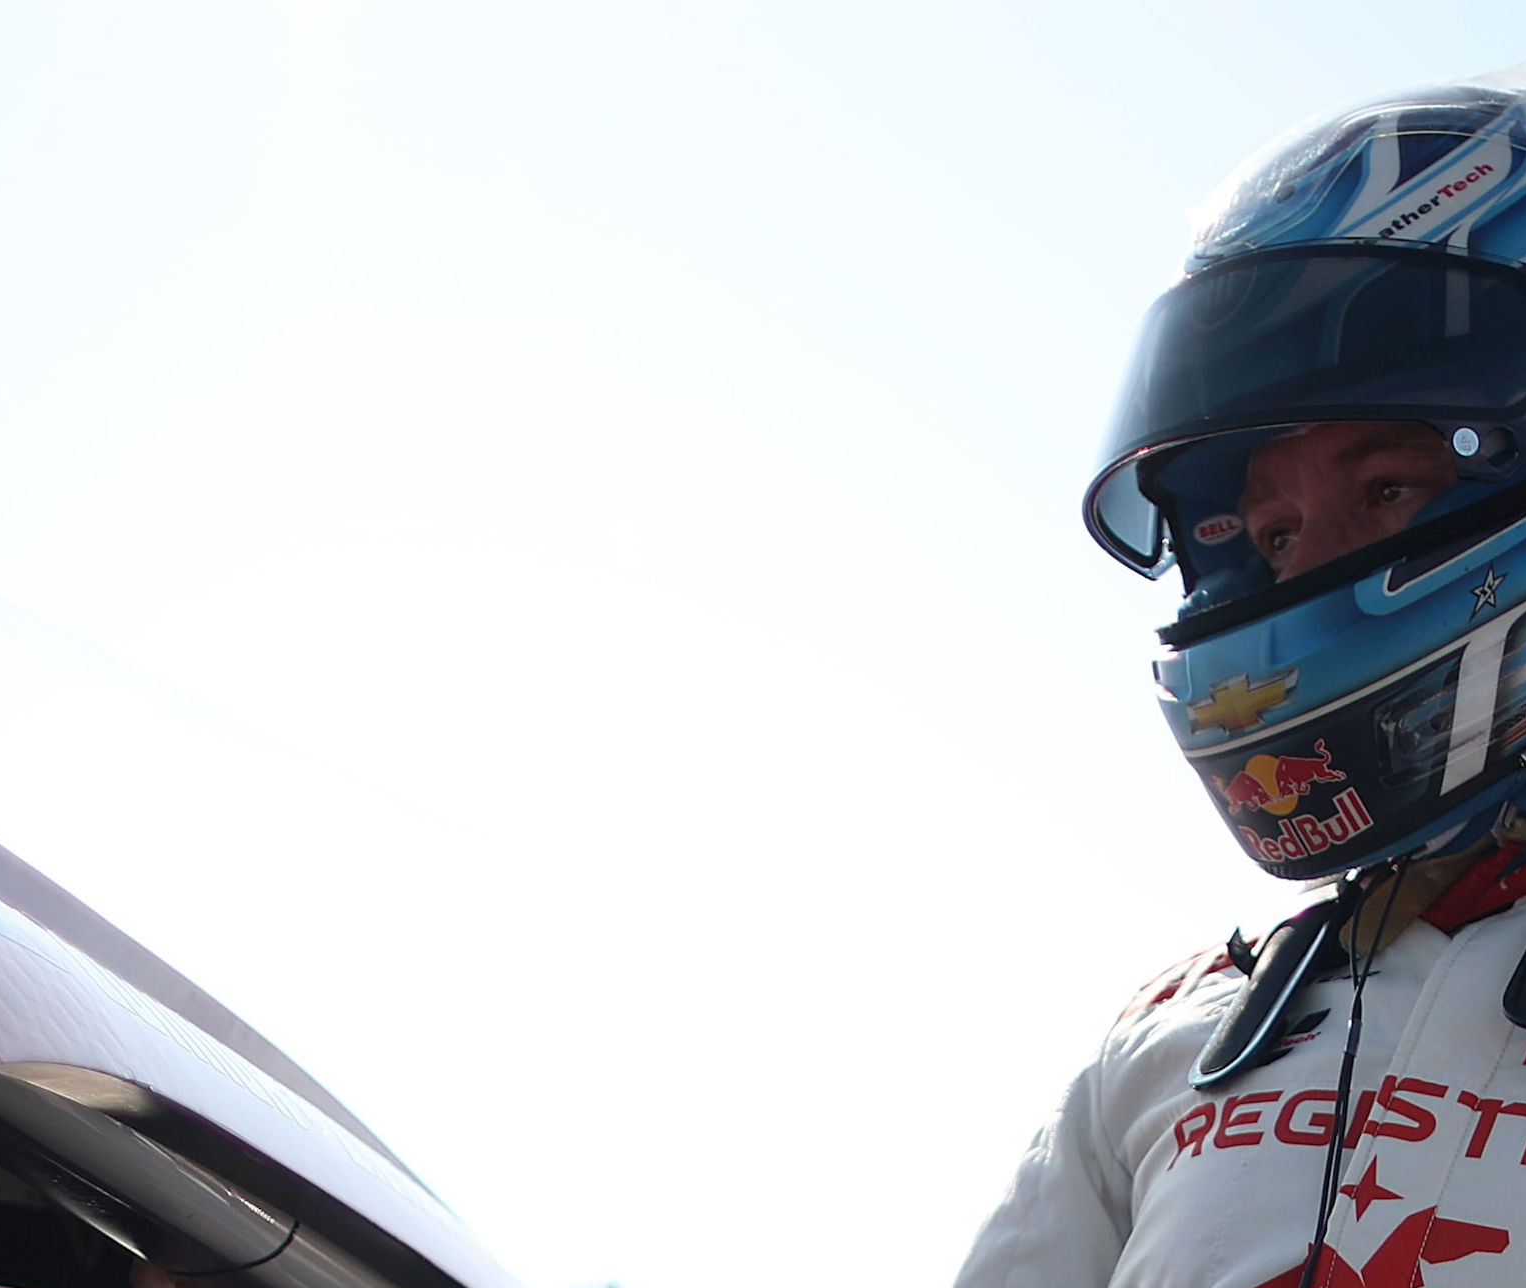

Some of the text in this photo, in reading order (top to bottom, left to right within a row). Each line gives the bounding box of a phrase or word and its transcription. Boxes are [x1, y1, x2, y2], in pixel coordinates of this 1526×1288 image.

[1377, 162, 1494, 240] atherTech
[1199, 519, 1238, 538] BELL
[1238, 786, 1374, 863] Red Bull
